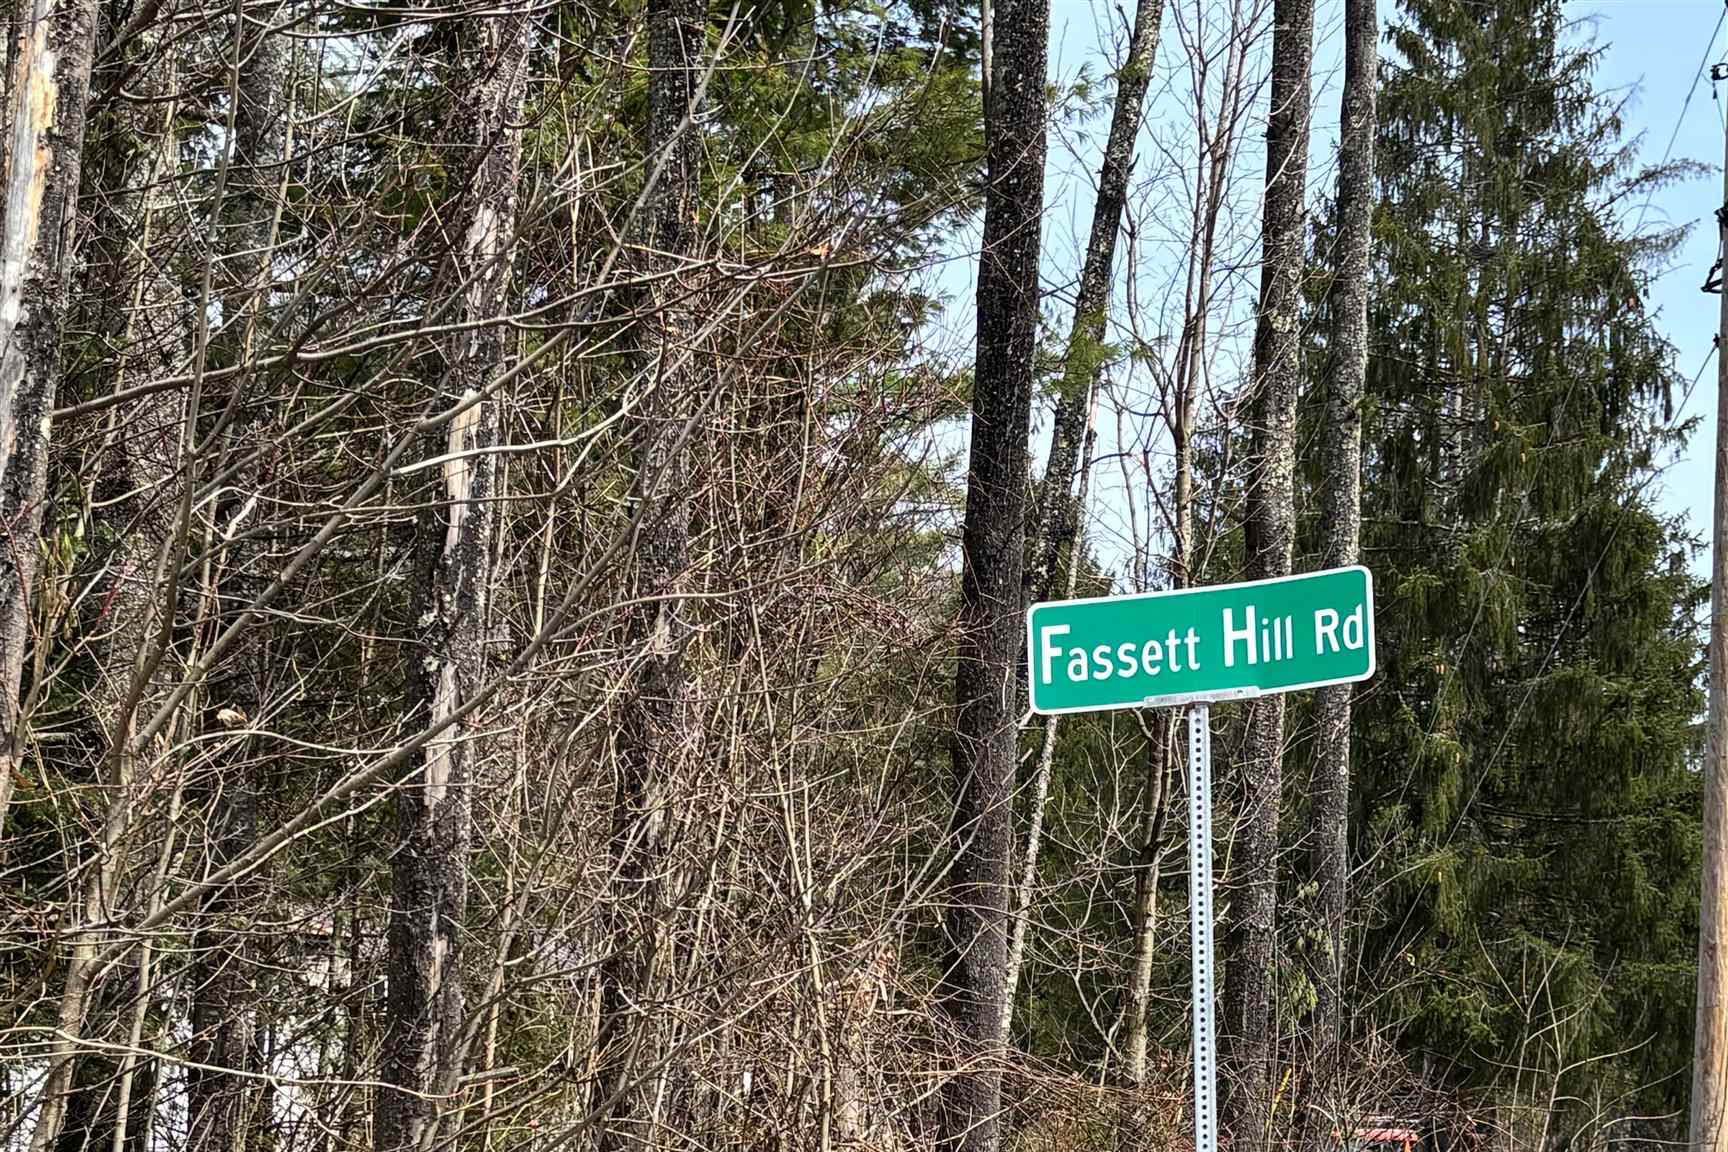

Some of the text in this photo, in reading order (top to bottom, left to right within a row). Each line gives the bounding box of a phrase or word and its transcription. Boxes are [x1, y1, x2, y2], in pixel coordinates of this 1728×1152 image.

[1040, 603, 1364, 684] Fassett Hill Rd
